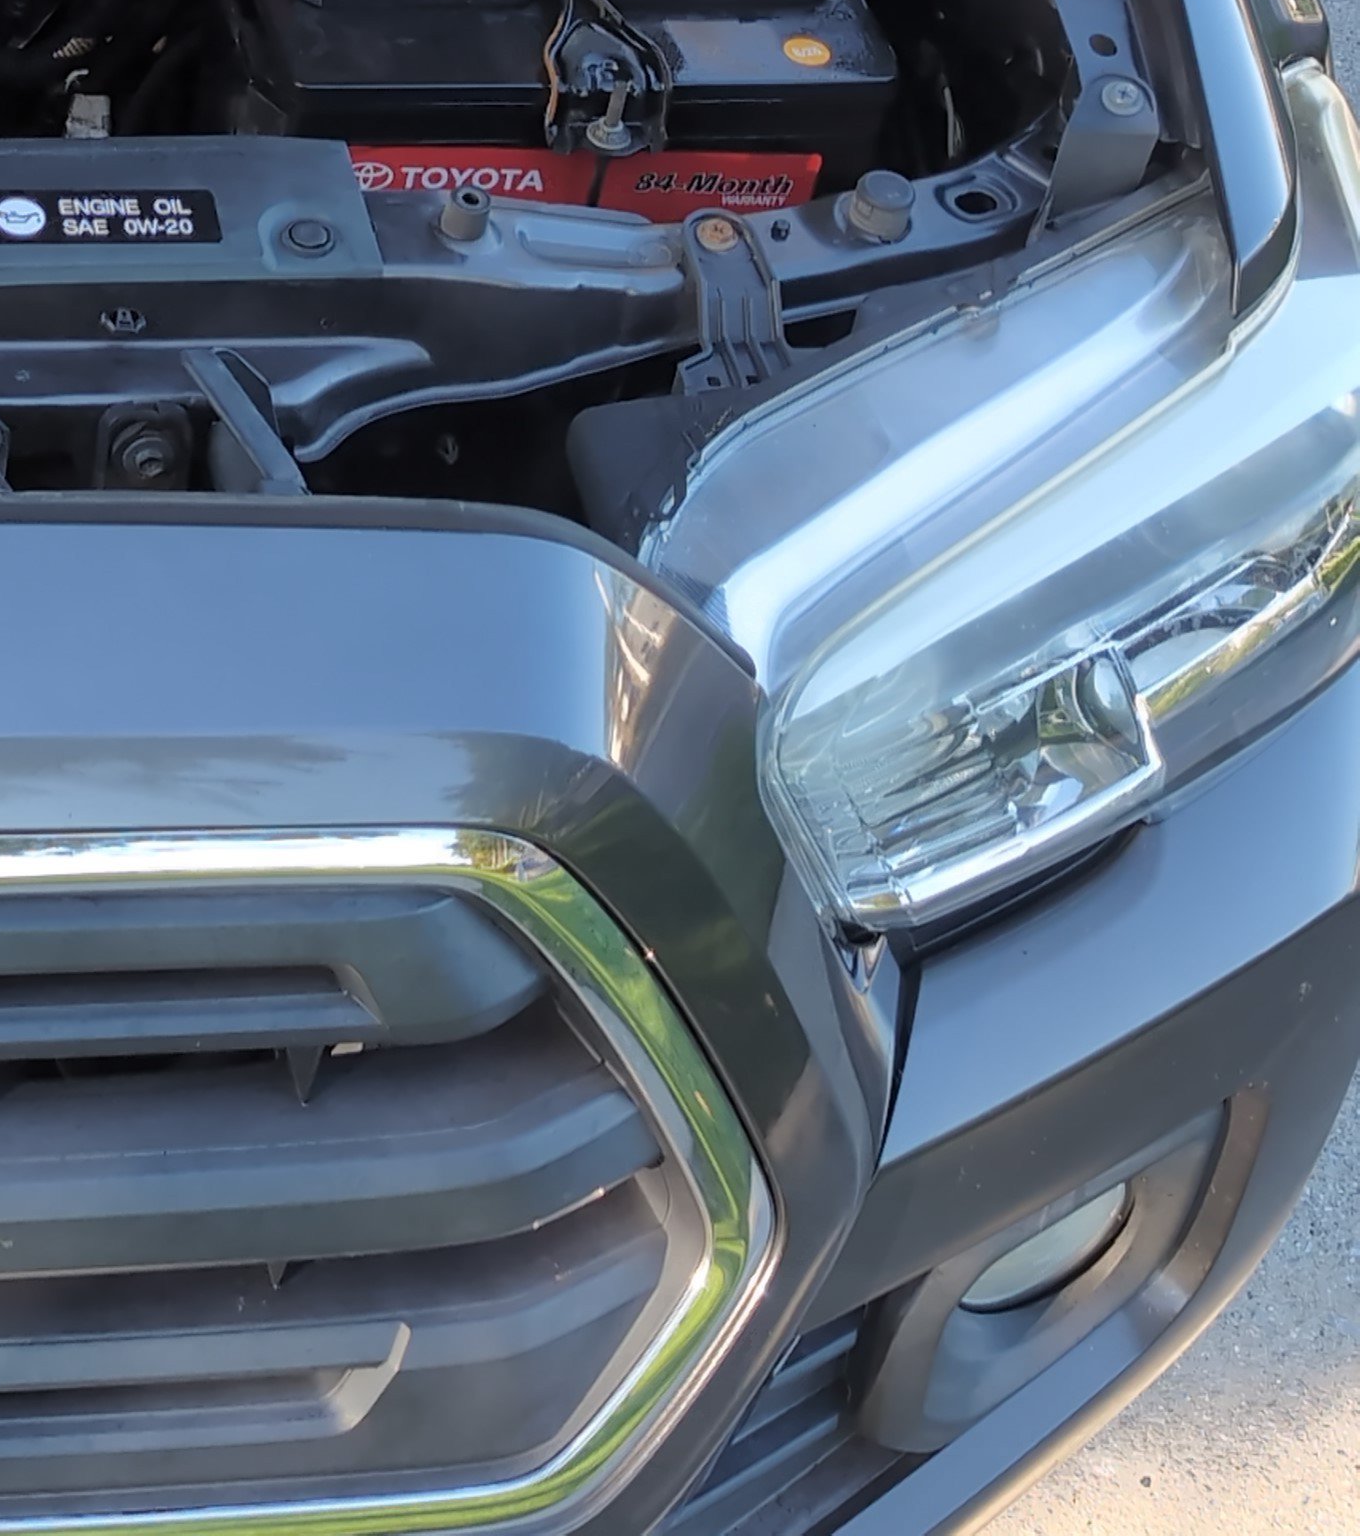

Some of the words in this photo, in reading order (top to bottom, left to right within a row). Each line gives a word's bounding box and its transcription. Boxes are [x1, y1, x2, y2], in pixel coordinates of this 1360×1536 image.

[401, 166, 545, 193] TOYOTA
[633, 171, 795, 196] 84-Month
[57, 198, 141, 216] ENGINE
[153, 198, 193, 216] OIL
[721, 194, 787, 207] WARRANTY
[62, 217, 110, 236] SAE
[123, 217, 194, 236] 0W-20
